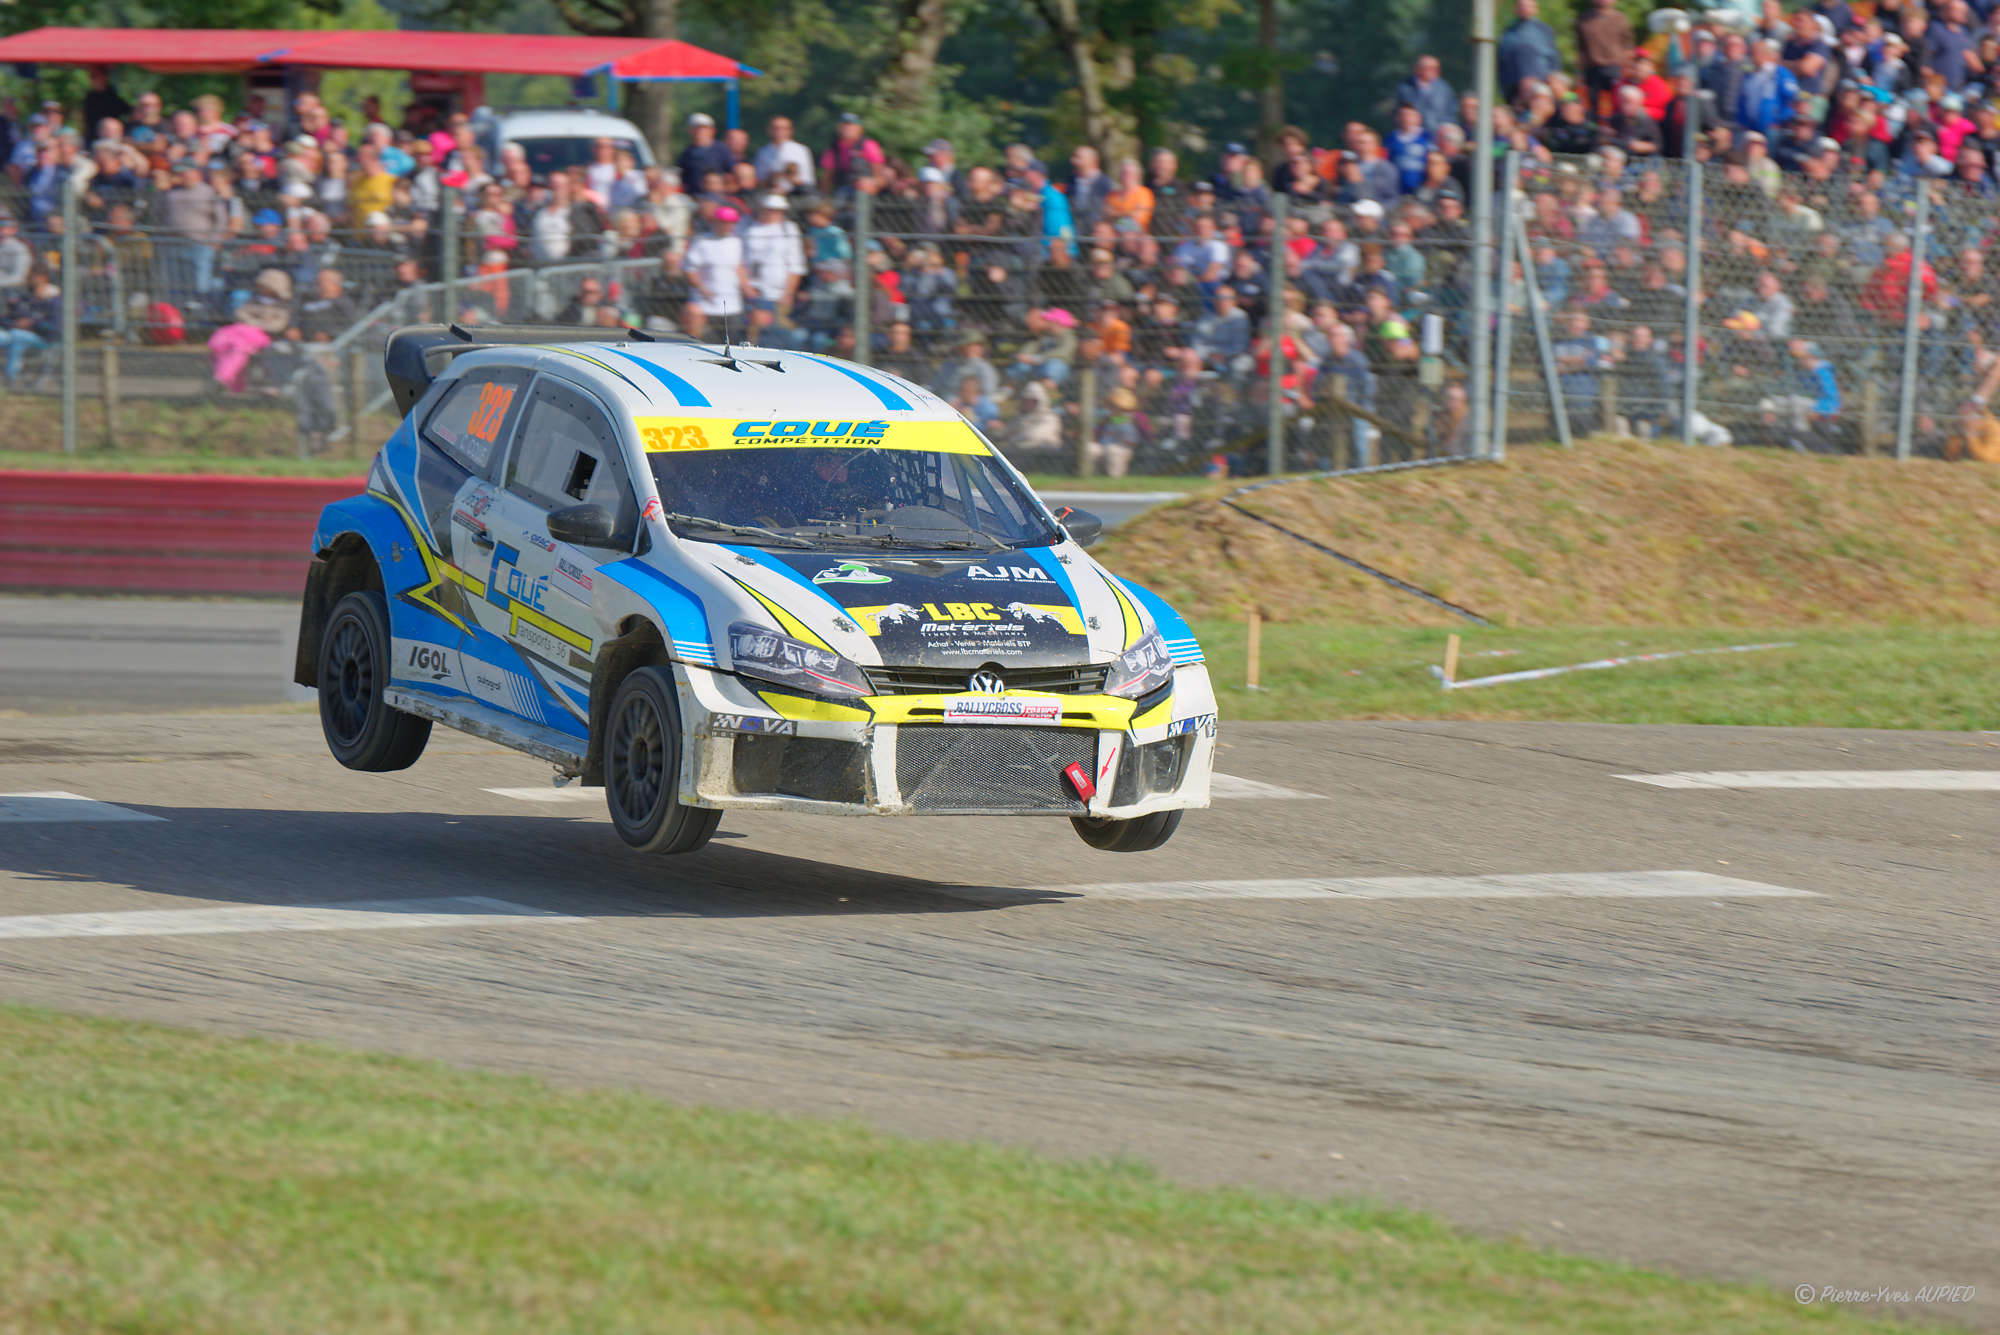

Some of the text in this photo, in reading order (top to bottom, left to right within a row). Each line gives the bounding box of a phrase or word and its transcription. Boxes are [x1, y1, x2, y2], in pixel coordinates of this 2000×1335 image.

[467, 382, 513, 443] 323
[732, 420, 890, 438] COUÉ
[643, 426, 709, 450] 323
[968, 566, 1048, 580] AJM
[922, 603, 1001, 620] LBC
[920, 621, 1025, 632] Matériels
[928, 640, 949, 648] Achat
[409, 646, 450, 673] IGOL
[954, 701, 1022, 715] RALLYCROSS
